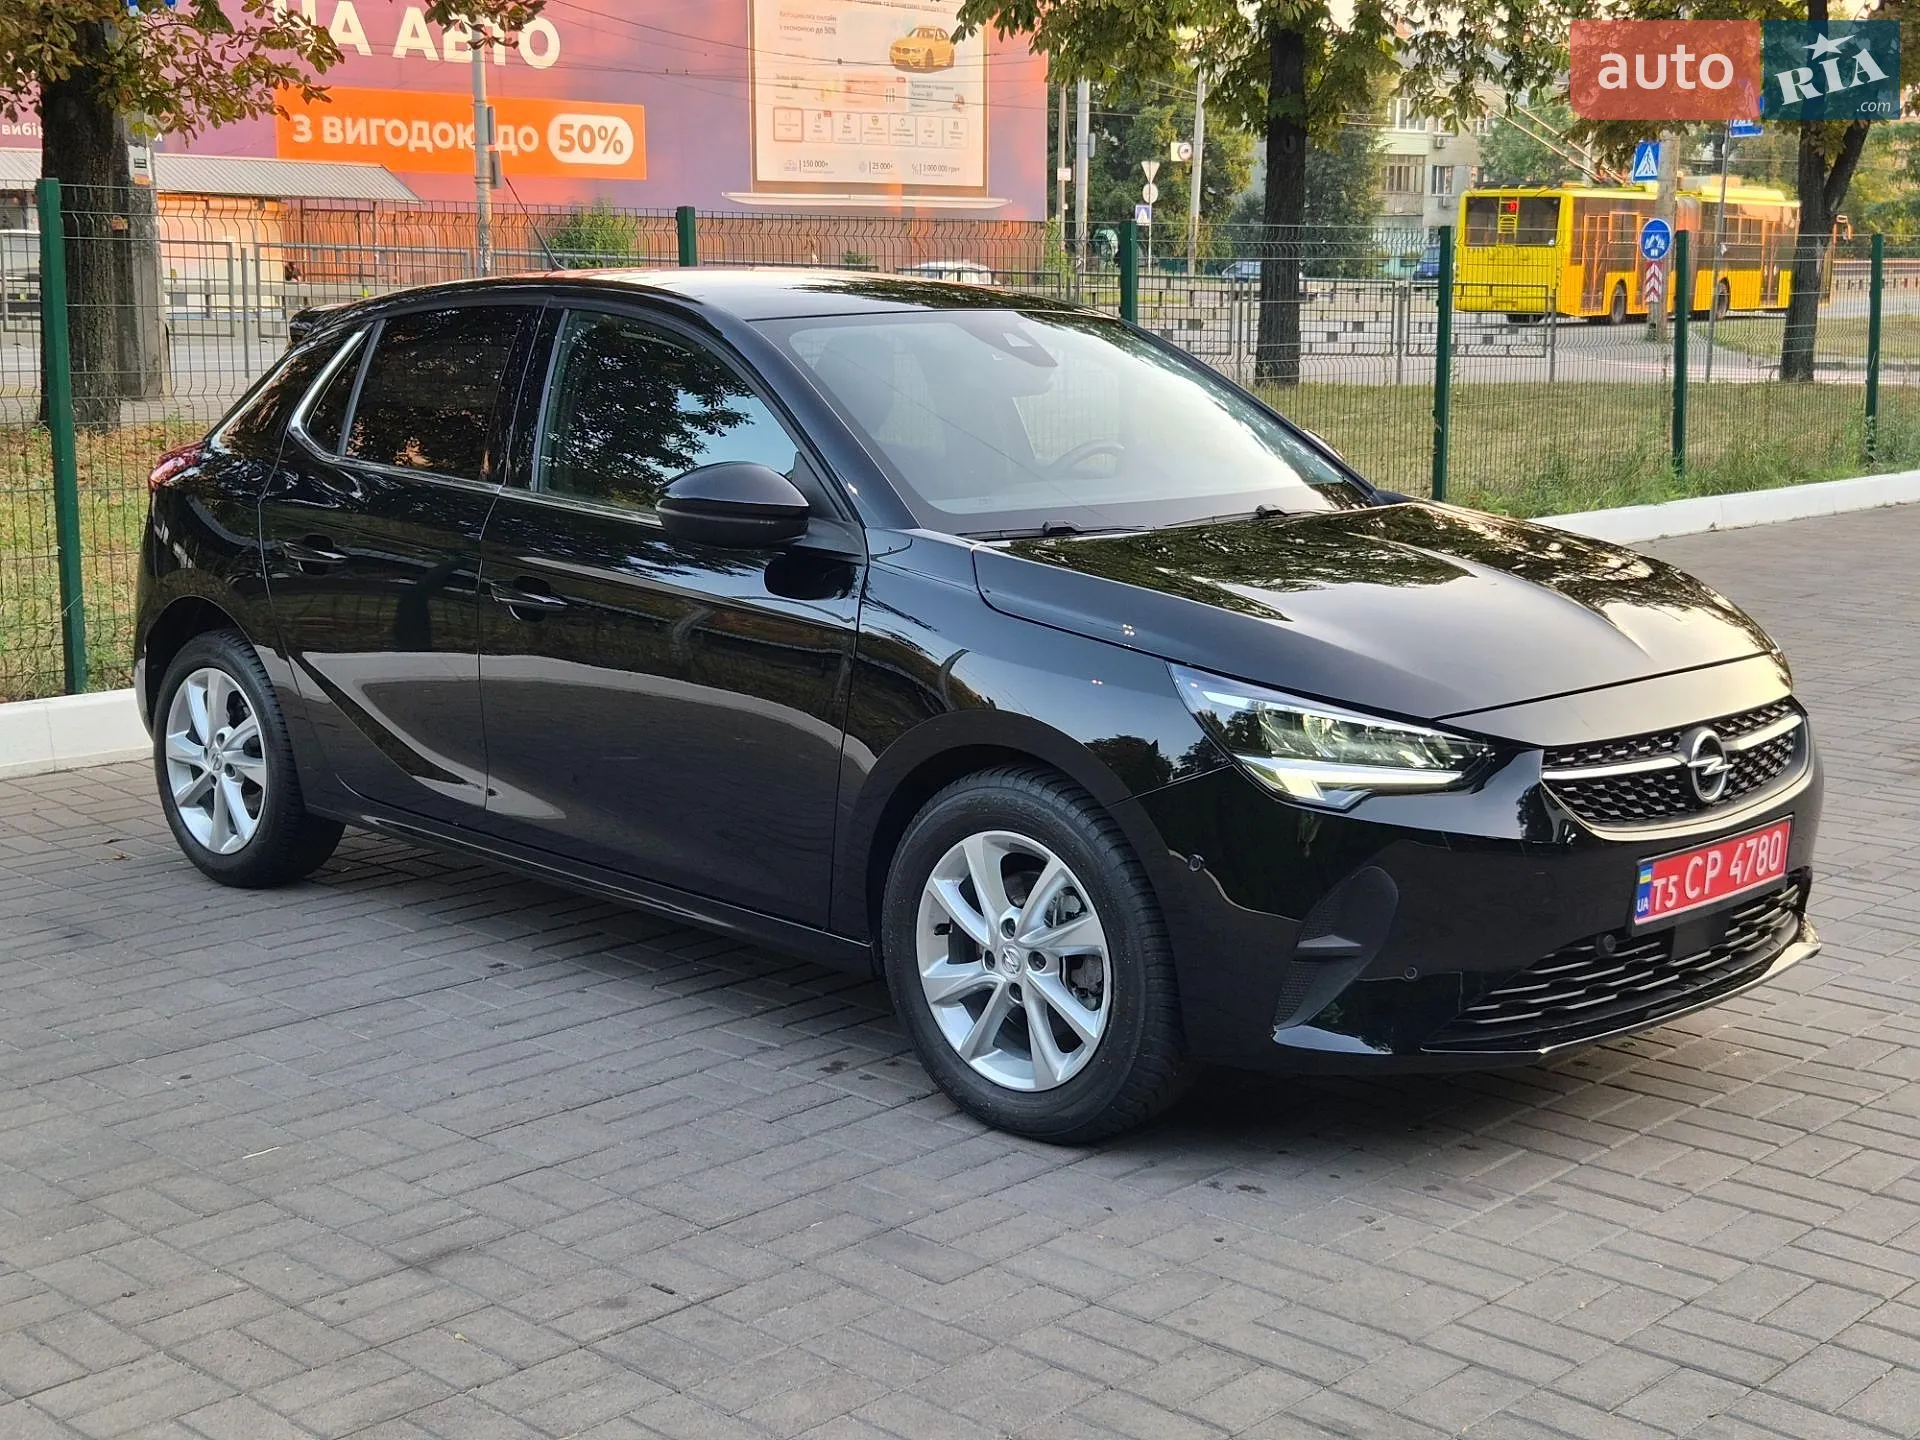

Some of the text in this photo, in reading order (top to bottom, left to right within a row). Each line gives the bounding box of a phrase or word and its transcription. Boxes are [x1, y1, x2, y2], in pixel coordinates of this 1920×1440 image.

[391, 7, 561, 70] АВТО
[291, 114, 313, 144] З
[321, 115, 477, 154] ВИГОДОЮ
[558, 123, 624, 155] 50%
[1652, 830, 1783, 911] T5 CP 4780
[1637, 896, 1649, 912] UA
